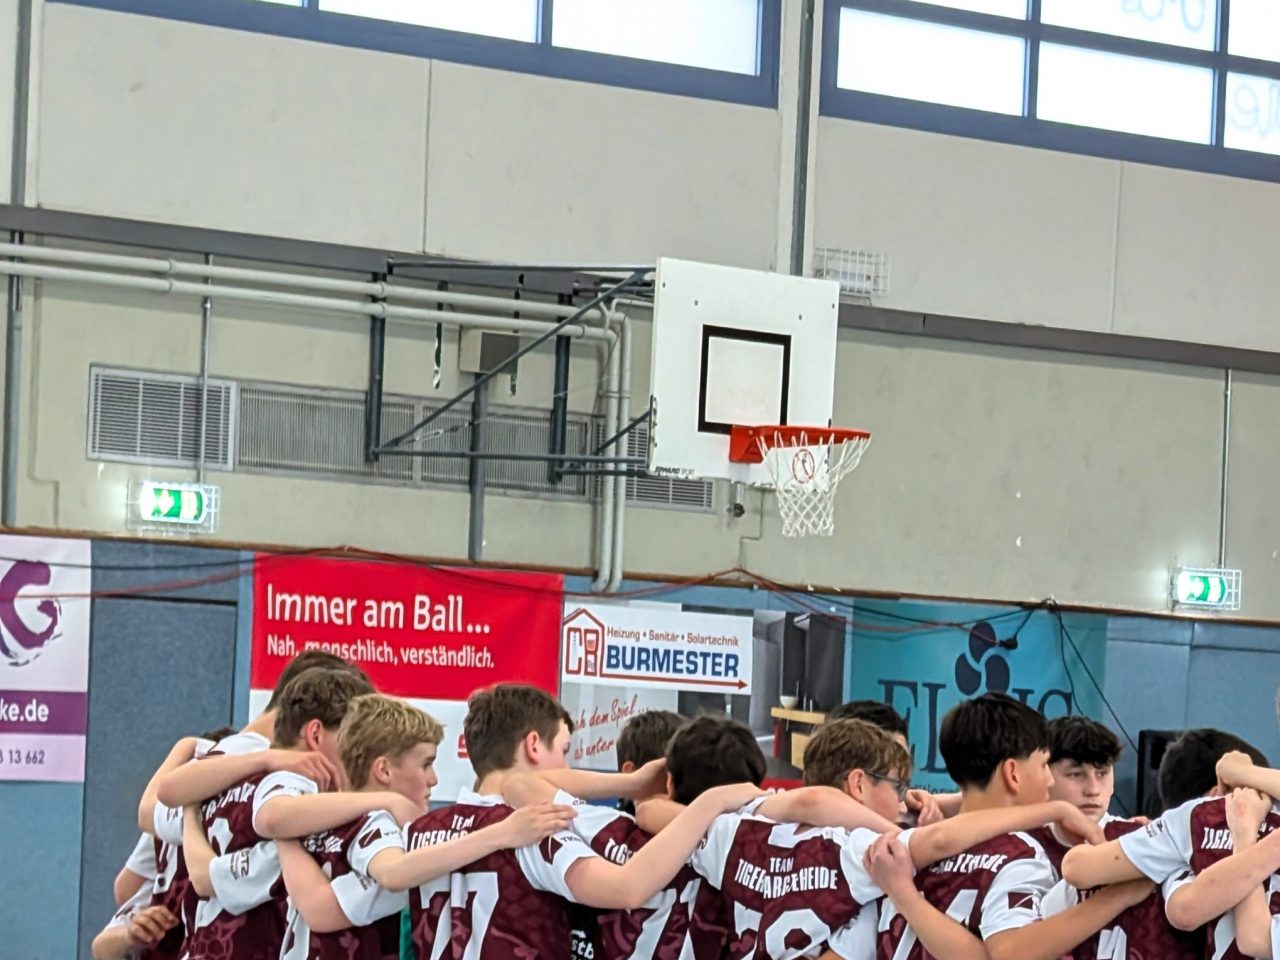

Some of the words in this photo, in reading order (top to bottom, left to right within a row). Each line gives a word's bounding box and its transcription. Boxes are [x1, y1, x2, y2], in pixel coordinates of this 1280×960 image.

[267, 584, 355, 625] Immer
[363, 600, 404, 629] am
[413, 595, 491, 634] Ball...
[267, 634, 300, 659] Nah,
[401, 645, 495, 669] verständlich.
[607, 626, 640, 642] Heizung
[649, 630, 680, 642] Sanitär
[687, 633, 739, 646] Solartechnik
[606, 645, 739, 678] BURMESTER
[589, 706, 609, 727] dem
[611, 694, 638, 728] Spiel
[9, 750, 21, 764] 13
[25, 751, 45, 765] 662
